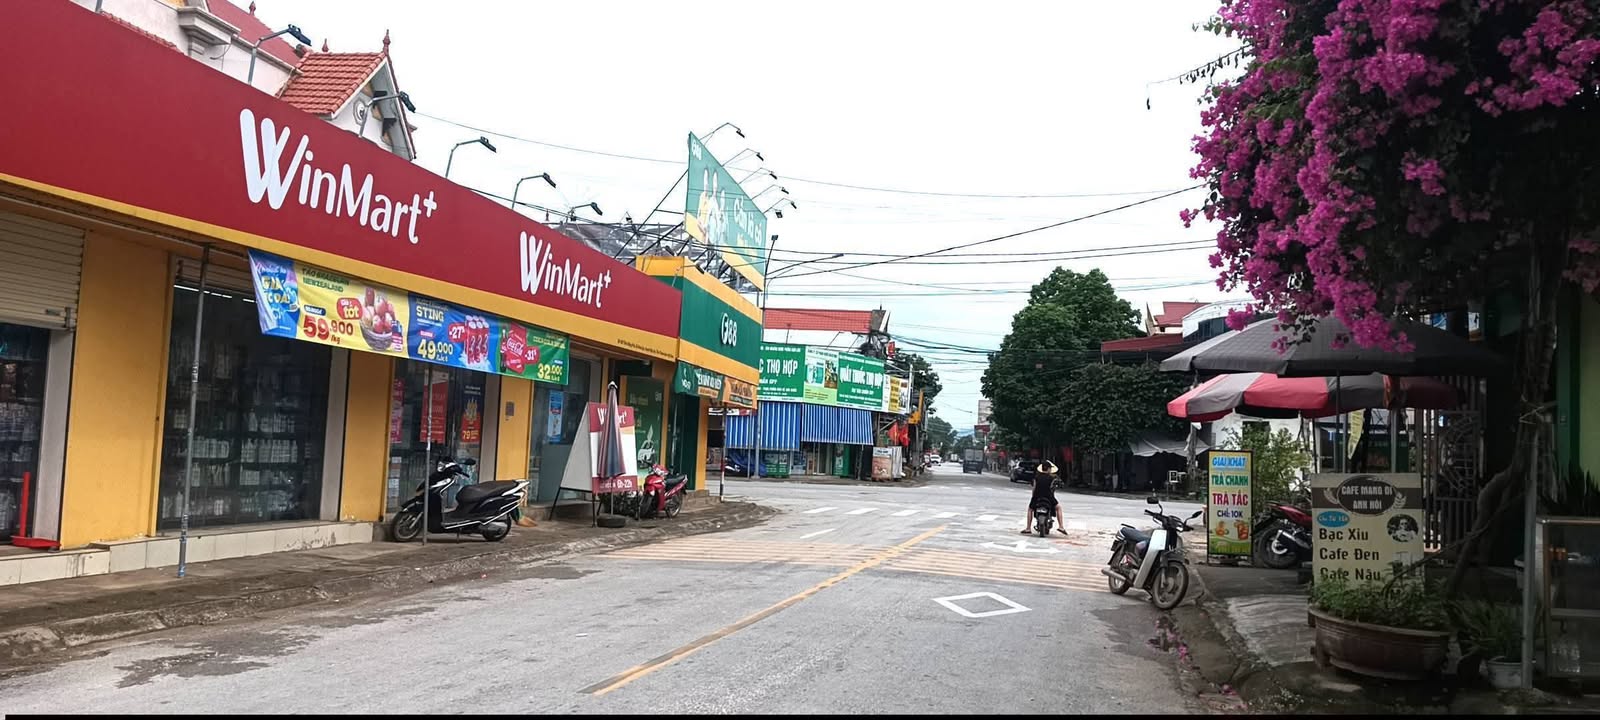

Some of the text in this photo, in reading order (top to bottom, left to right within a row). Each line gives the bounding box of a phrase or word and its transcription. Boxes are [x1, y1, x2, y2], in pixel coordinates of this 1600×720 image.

[239, 108, 438, 245] WinMart+
[519, 230, 613, 309] WinMart+
[416, 305, 444, 322] STING
[418, 338, 454, 360] 49.000
[766, 359, 781, 377] THỌ
[782, 358, 798, 378] HỢP
[1228, 456, 1247, 467] KHÁT
[1211, 472, 1249, 486] TRÀ CHANH
[1342, 486, 1359, 495] CAFE
[1360, 486, 1383, 495] MANG
[1212, 491, 1230, 505] TRÀ
[1353, 500, 1368, 510] ANH
[1231, 510, 1244, 518] 10K
[1319, 528, 1344, 542] Bạc
[1320, 548, 1380, 561] Cafe Đen
[1320, 567, 1350, 582] Cafe
